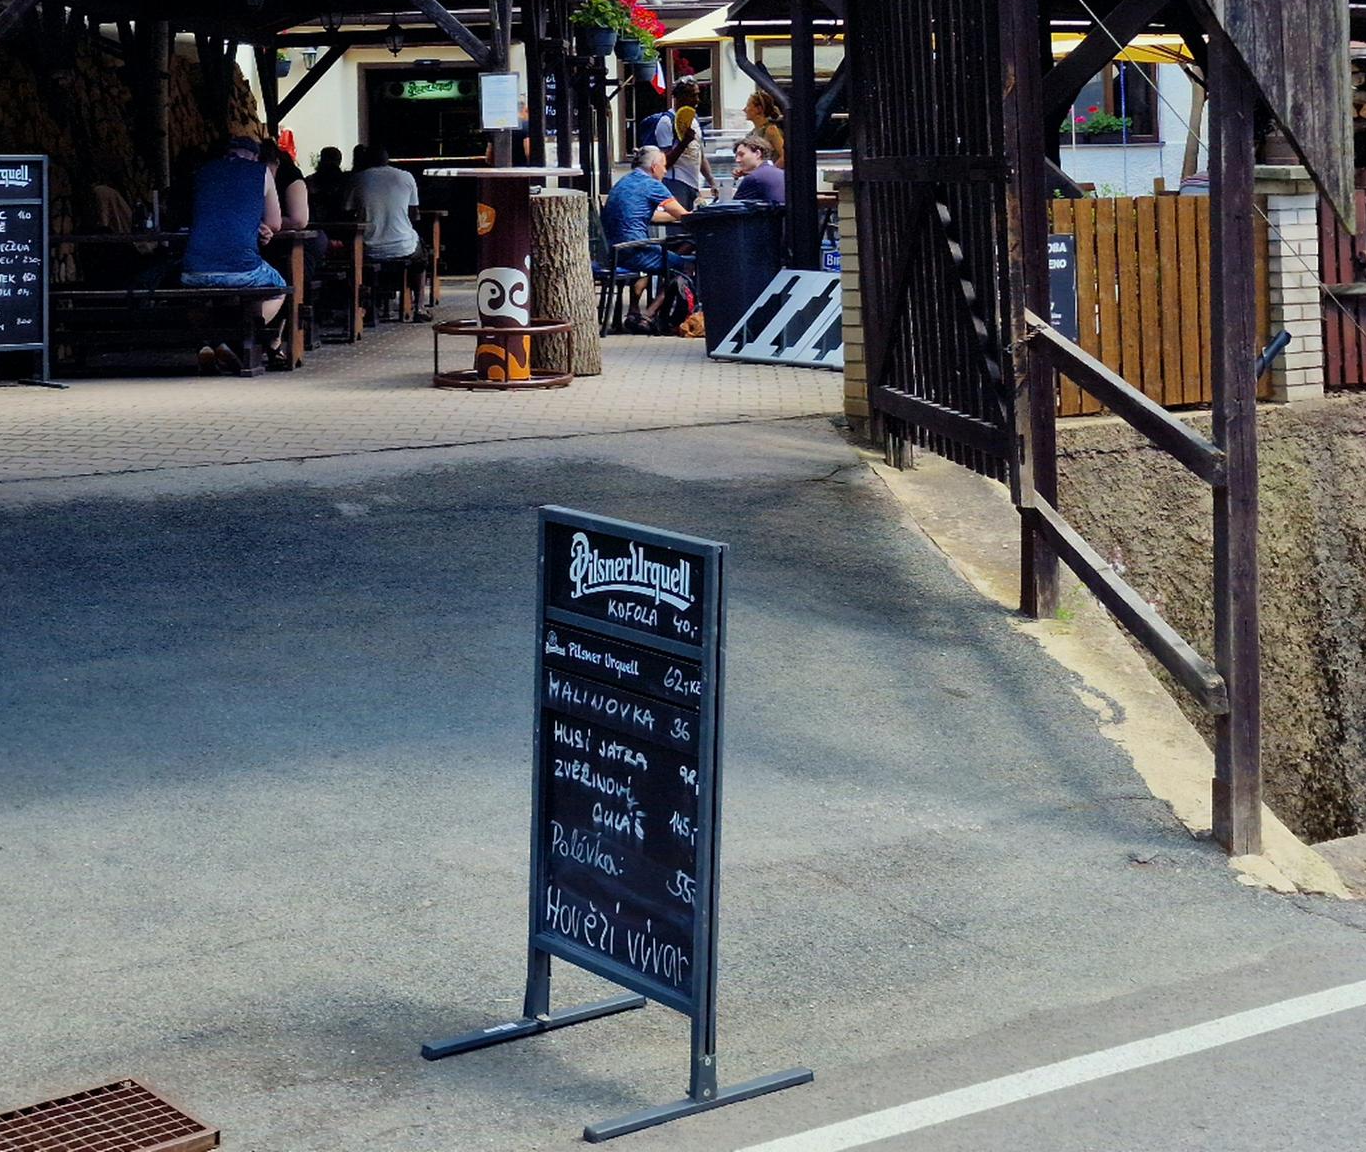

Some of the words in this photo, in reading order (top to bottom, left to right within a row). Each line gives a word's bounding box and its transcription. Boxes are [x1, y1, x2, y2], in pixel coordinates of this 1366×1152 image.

[569, 532, 632, 598] Pilsner
[629, 541, 691, 605] Urquell
[608, 599, 658, 627] KOFOLA
[568, 642, 601, 665] Pilsner
[604, 652, 640, 679] Urquell
[548, 671, 655, 731] MALINOVKA
[670, 718, 691, 741] 36
[554, 720, 591, 752] HUSÍ
